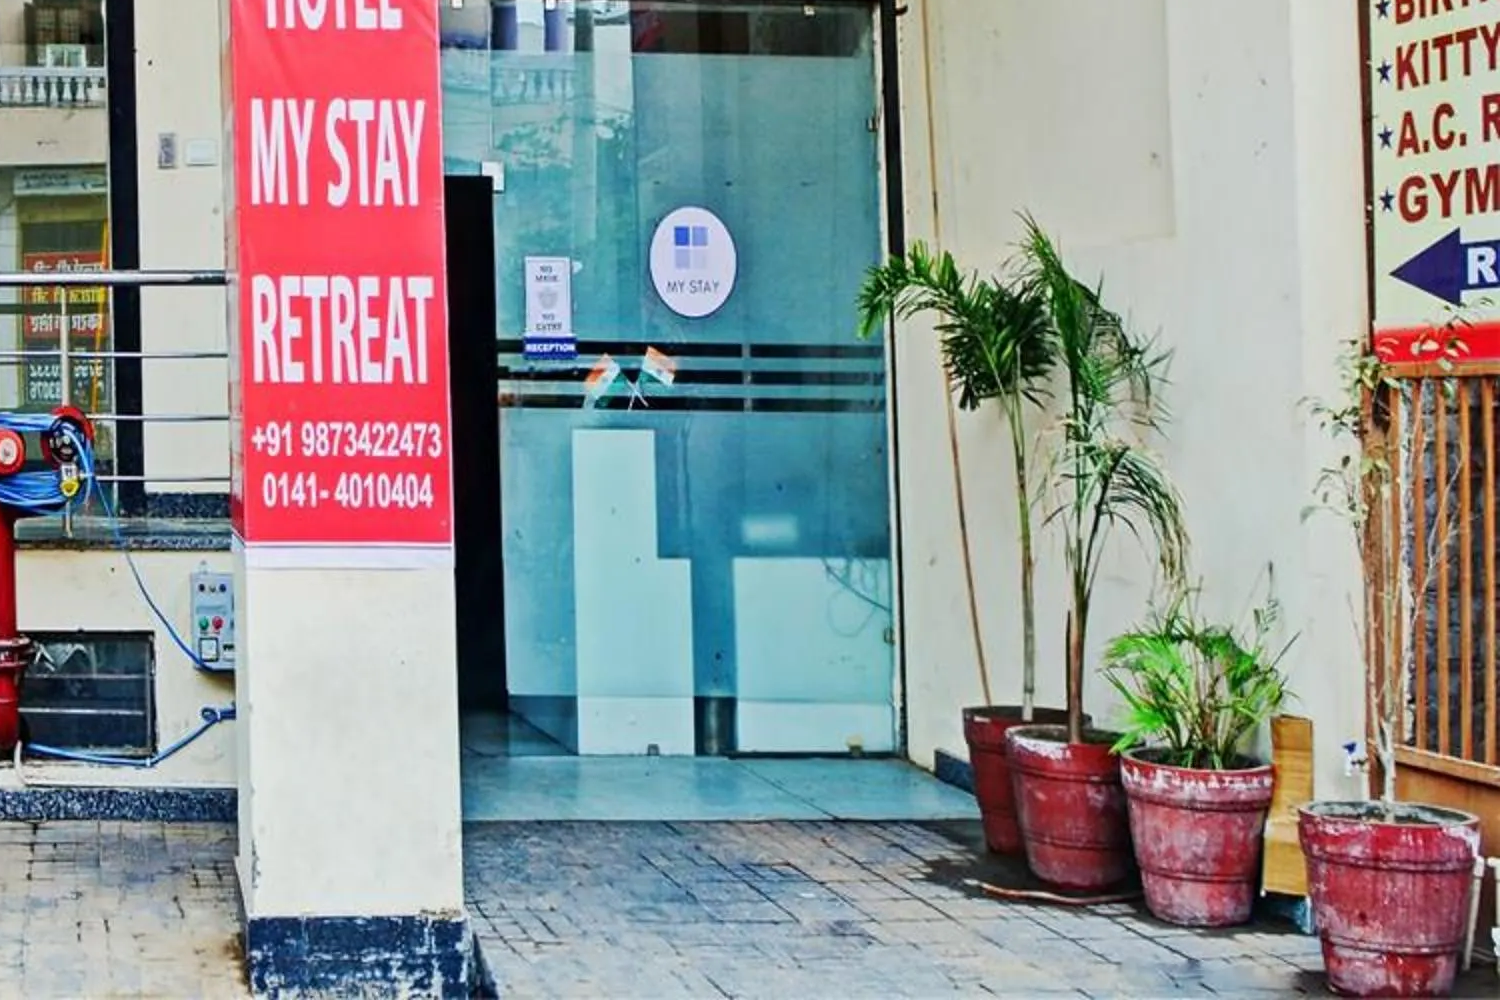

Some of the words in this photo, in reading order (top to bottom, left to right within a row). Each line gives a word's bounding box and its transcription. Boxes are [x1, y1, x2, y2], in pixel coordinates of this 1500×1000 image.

[1396, 22, 1500, 90] KITTY
[251, 98, 313, 206] MY
[325, 98, 425, 207] STAY
[1397, 103, 1467, 158] A.C.
[1399, 163, 1500, 224] GYM
[667, 279, 685, 293] MY
[689, 279, 720, 294] STAY
[252, 275, 434, 383] RETREAT
[525, 342, 576, 353] RECEPTION
[251, 422, 293, 458] +91
[301, 421, 443, 458] 9873422473
[262, 473, 329, 508] 0141-
[334, 472, 433, 508] 4010404
